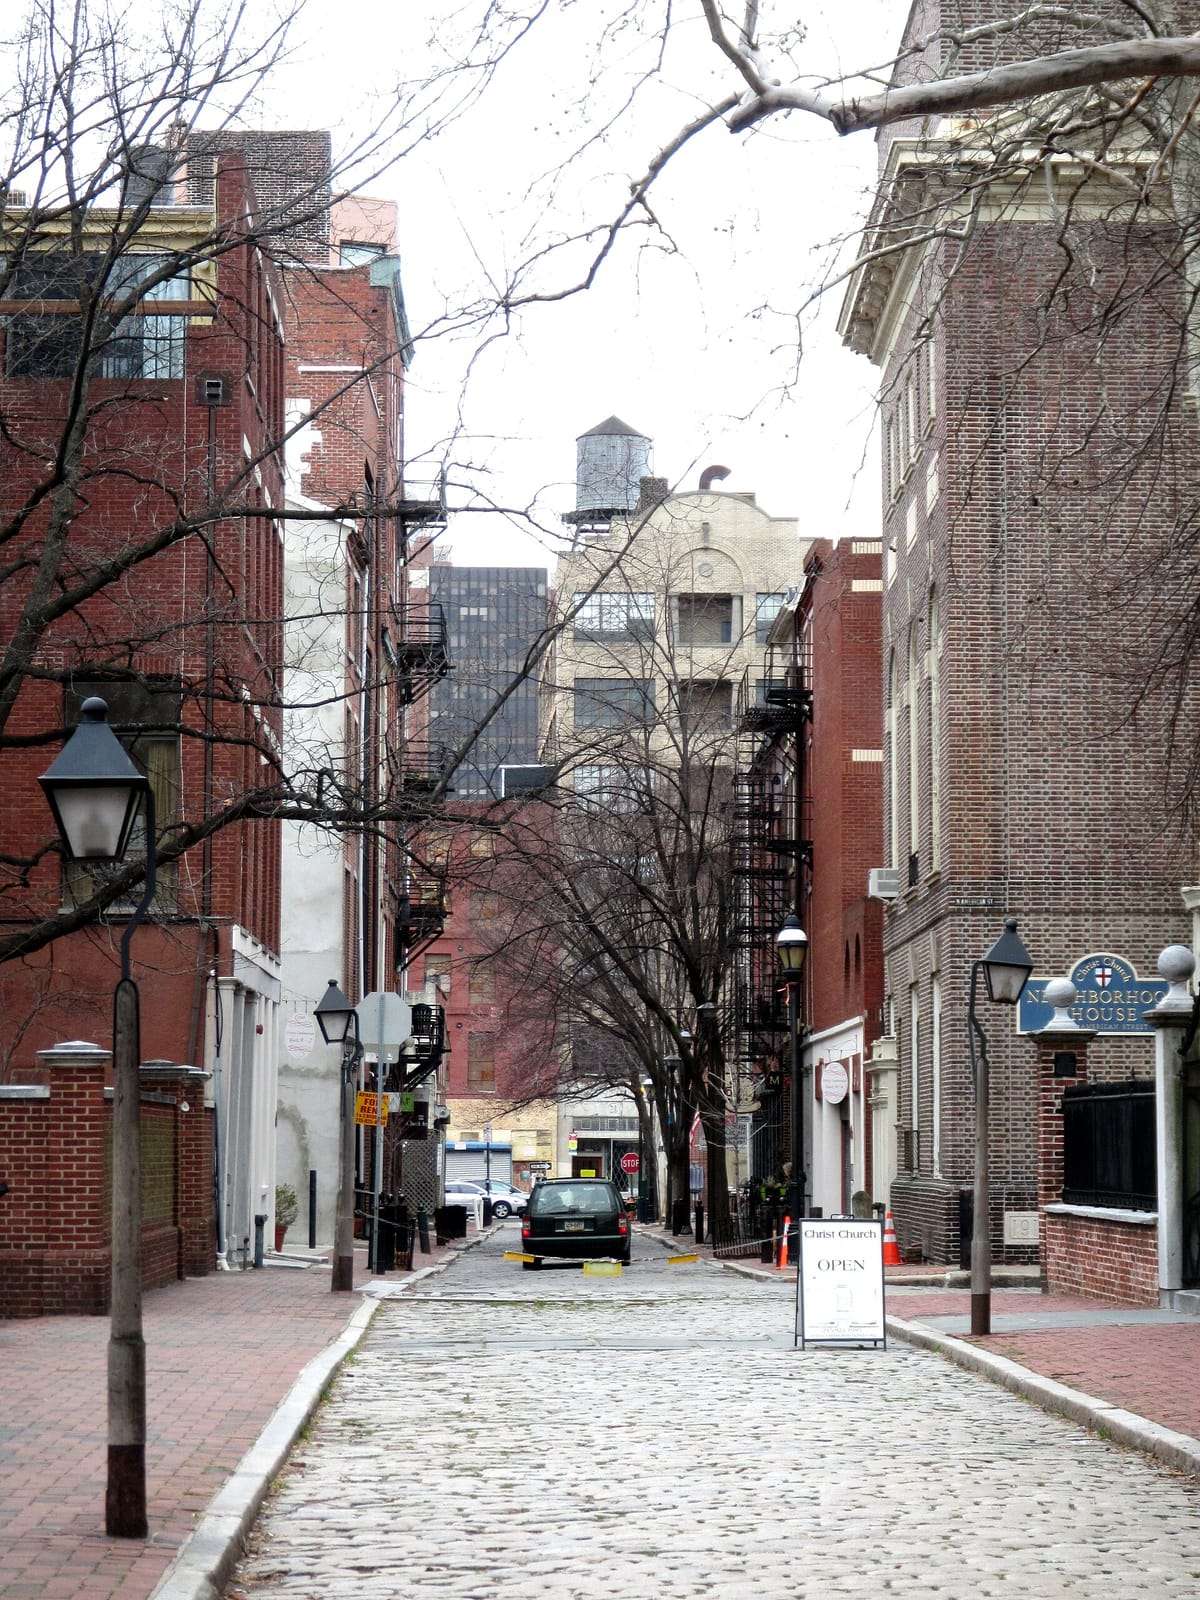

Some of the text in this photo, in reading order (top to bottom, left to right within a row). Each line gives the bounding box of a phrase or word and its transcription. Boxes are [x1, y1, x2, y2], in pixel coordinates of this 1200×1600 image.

[1076, 957, 1132, 984] Christ Church
[1027, 989, 1165, 1004] NEHBORHOO
[1071, 1007, 1138, 1022] HOUSE
[1081, 1023, 1149, 1031] AMERICAN STREET
[769, 1075, 780, 1085] M
[804, 1229, 877, 1239] Christ Church
[817, 1259, 865, 1272] OPEN
